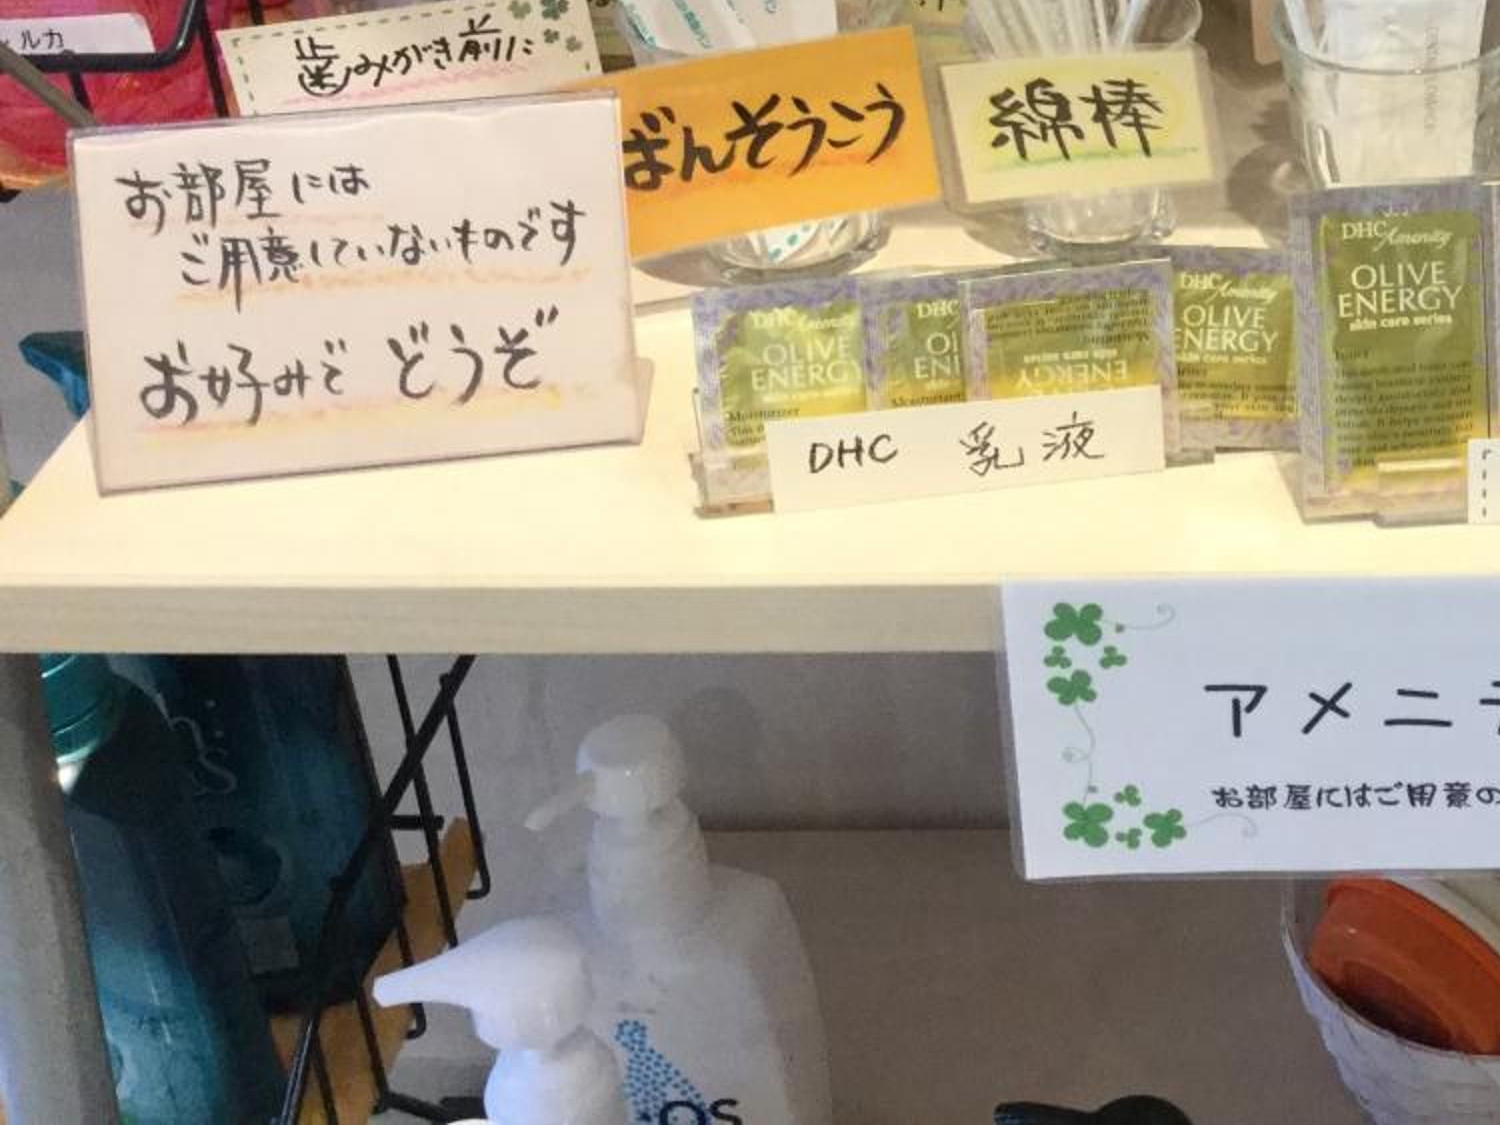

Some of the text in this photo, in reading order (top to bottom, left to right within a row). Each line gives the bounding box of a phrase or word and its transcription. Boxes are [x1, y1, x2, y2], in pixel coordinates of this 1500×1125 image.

[2, 30, 65, 52] ルカ
[295, 13, 533, 97] 歯みがき前に
[623, 82, 907, 192] ばんそうこう
[989, 77, 1164, 162] 綿棒
[116, 159, 369, 235] お部屋には
[1341, 220, 1388, 241] DHC
[179, 198, 588, 312] ご用意していないものです
[1180, 271, 1222, 290] DHC
[1350, 260, 1448, 291] OLIVE
[1182, 305, 1267, 329] OLIVE
[1337, 283, 1464, 319] ENERGY
[1349, 312, 1453, 332] skin care series
[139, 305, 560, 427] お好みで どうぞ
[763, 336, 851, 366] OLIVE
[809, 433, 899, 474] DHC
[959, 411, 1105, 476] 乳液
